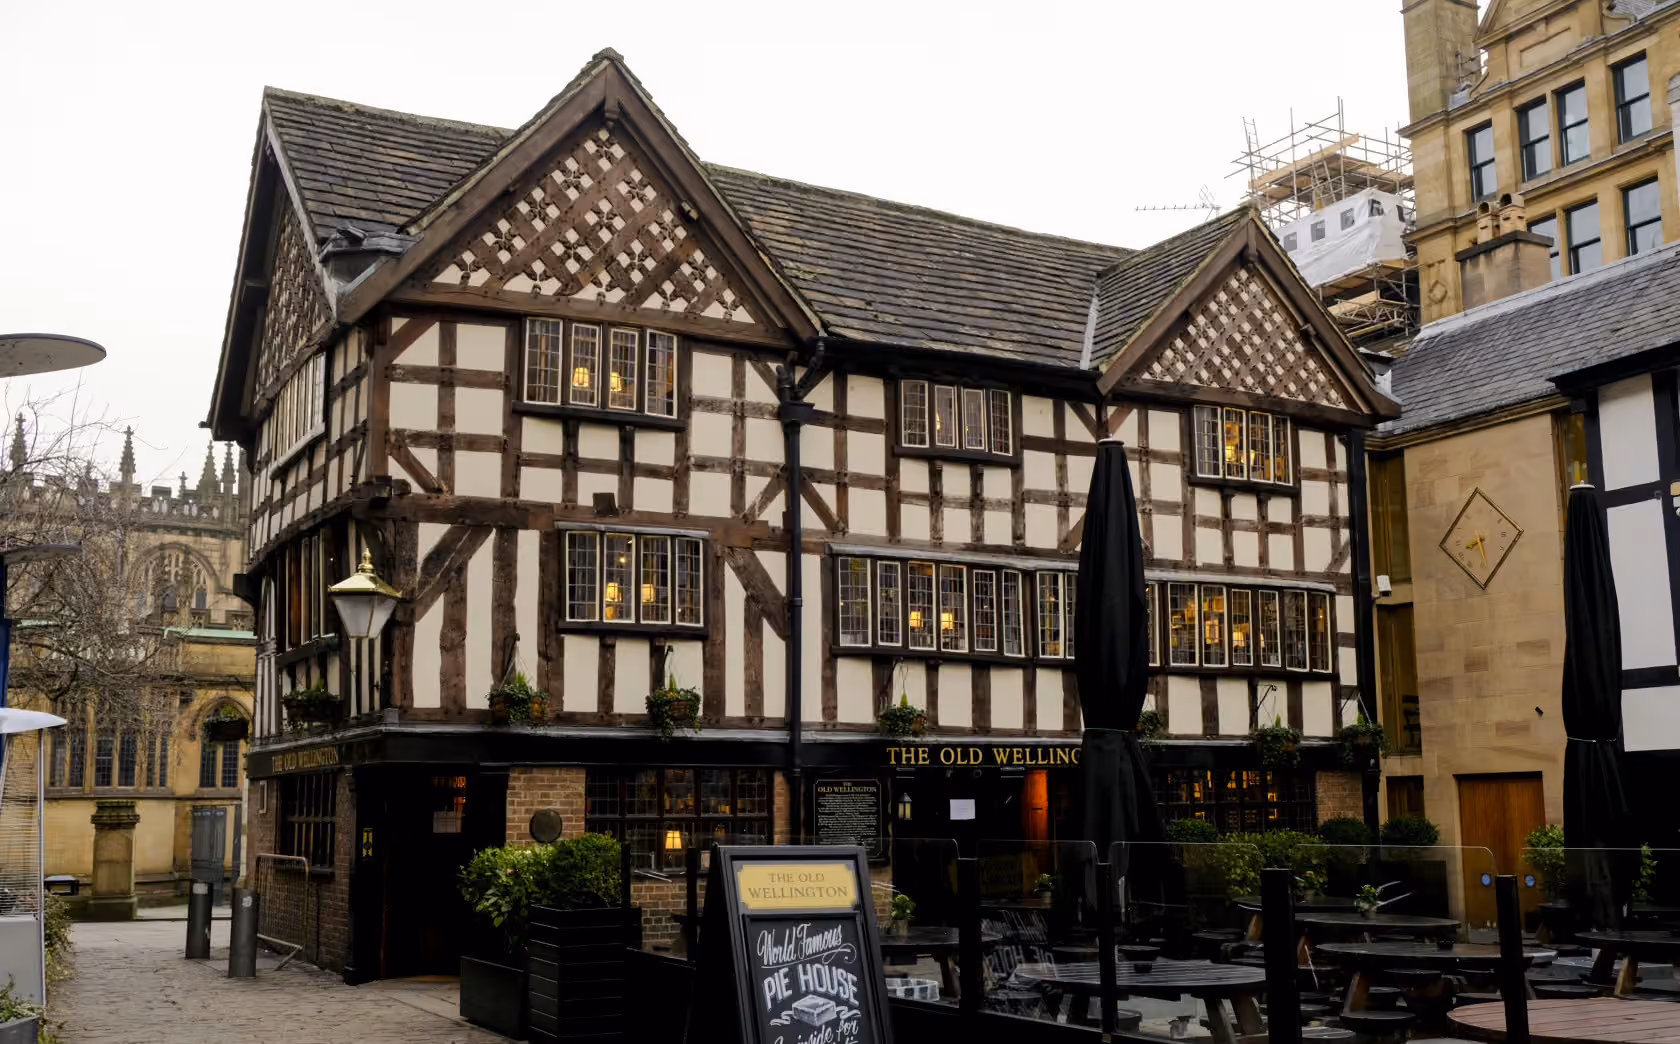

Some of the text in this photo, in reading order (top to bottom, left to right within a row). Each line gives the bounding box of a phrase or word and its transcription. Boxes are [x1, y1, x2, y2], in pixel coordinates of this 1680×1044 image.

[272, 755, 283, 773] THE
[284, 752, 297, 771] OLD
[886, 747, 930, 765] THE
[940, 747, 983, 765] OLD
[768, 872, 825, 883] THE OLD
[747, 886, 848, 899] WELLINGTON
[757, 922, 843, 966] World Famous
[762, 963, 860, 1012] PIE HOUSE
[797, 1024, 834, 1044] side
[836, 1018, 859, 1042] for
